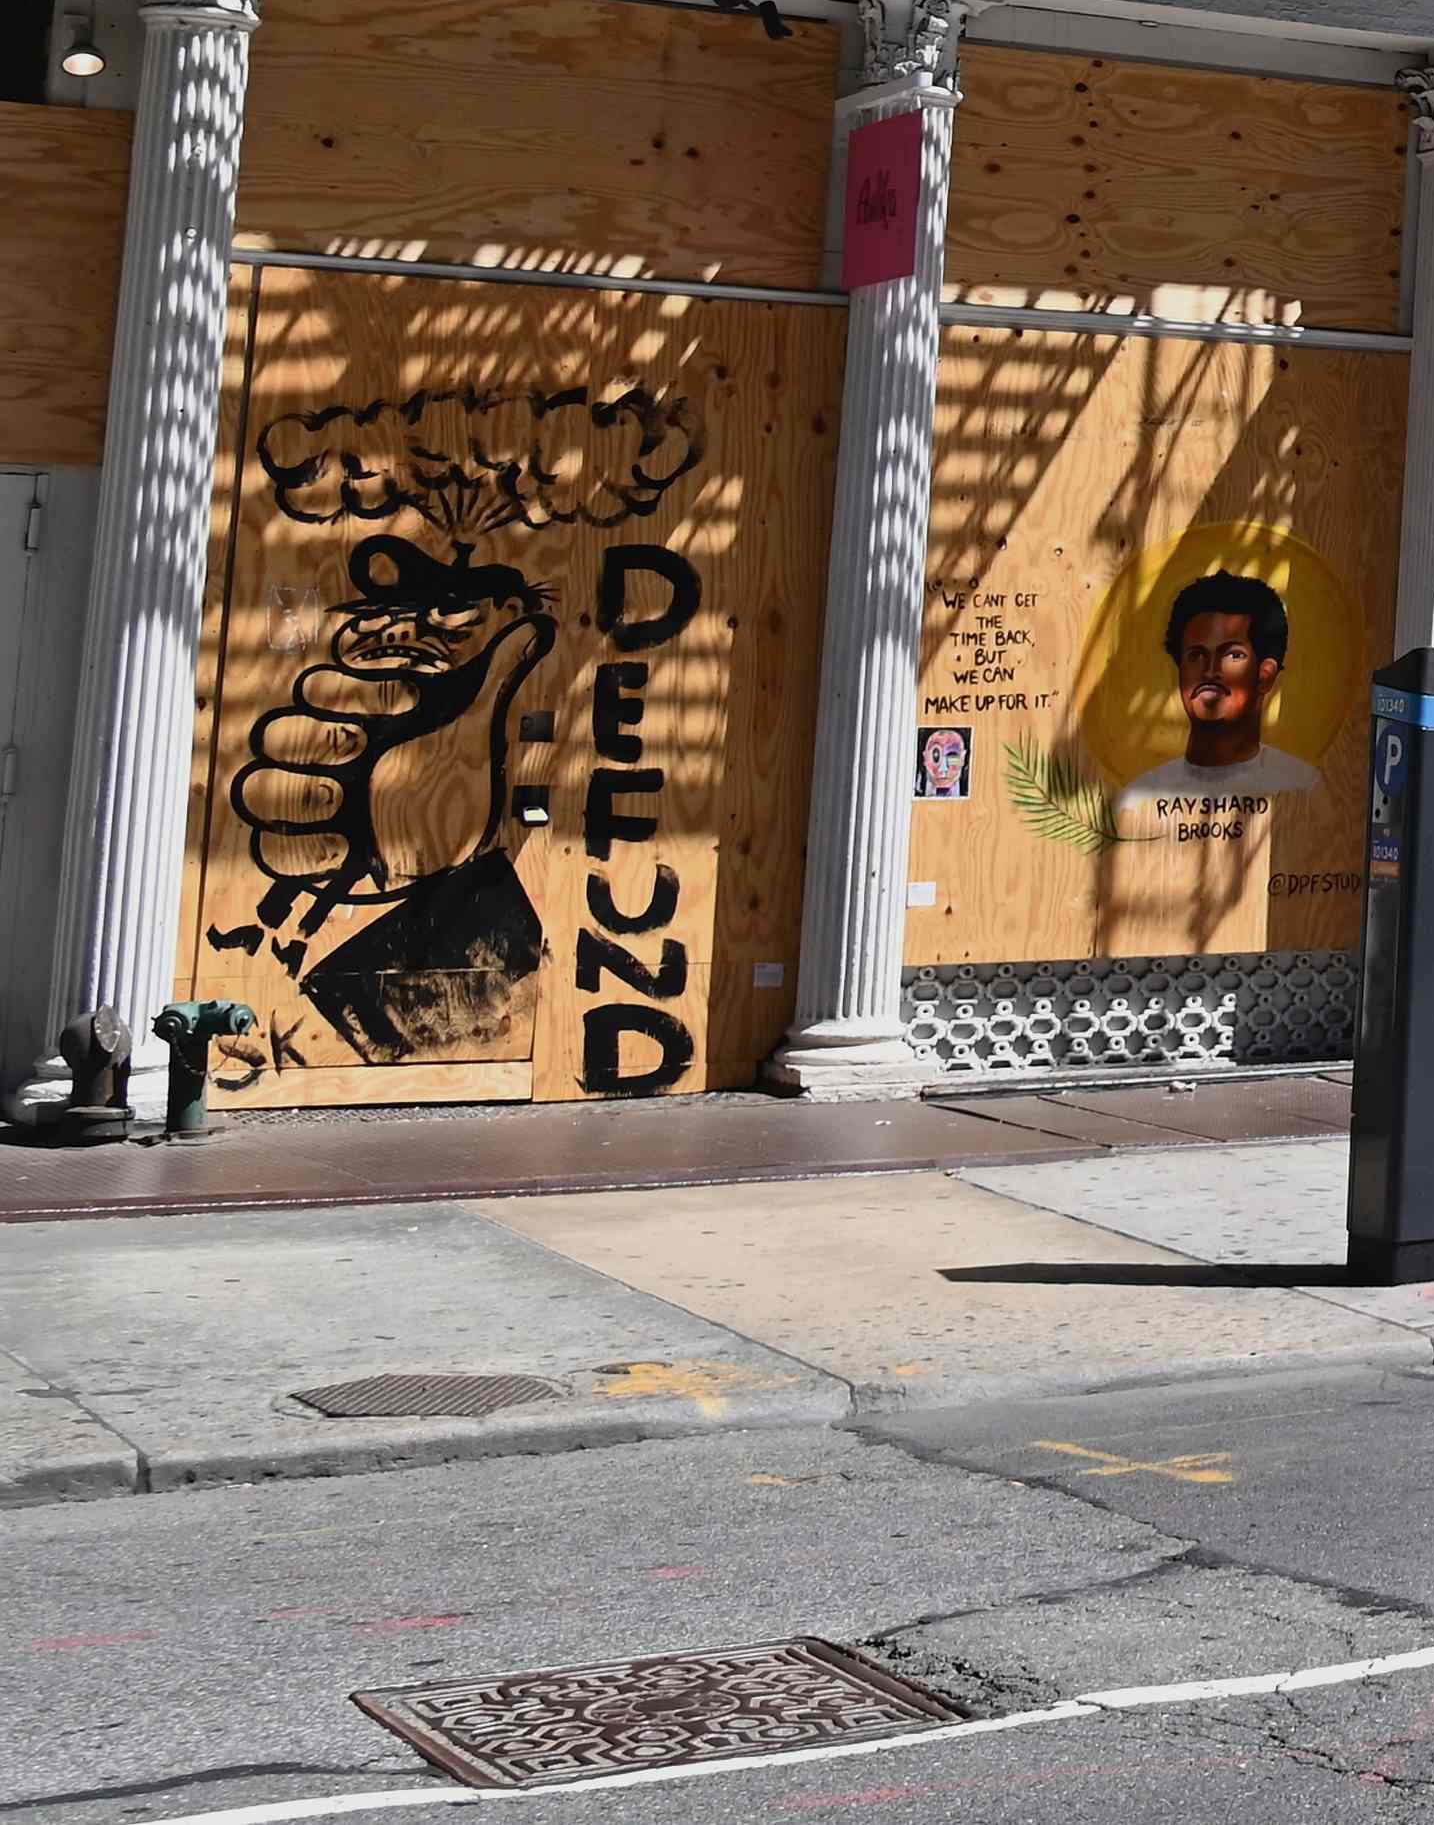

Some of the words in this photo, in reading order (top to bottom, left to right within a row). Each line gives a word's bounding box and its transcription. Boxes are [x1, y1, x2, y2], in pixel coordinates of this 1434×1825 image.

[943, 591, 966, 609] WE
[973, 592, 1008, 608] CANT
[1015, 592, 1039, 607] GET
[976, 615, 1003, 629] THE
[950, 632, 986, 646] TIME
[975, 649, 1006, 666] BUT
[953, 670, 978, 685] WE
[983, 667, 1015, 683] CAN
[925, 694, 971, 714] MAKE
[976, 694, 995, 711] UP
[999, 693, 1028, 710] FOR
[1157, 796, 1268, 819] RAYSHARD
[576, 543, 703, 1094] DEFUND
[1178, 822, 1244, 841] BROOKS
